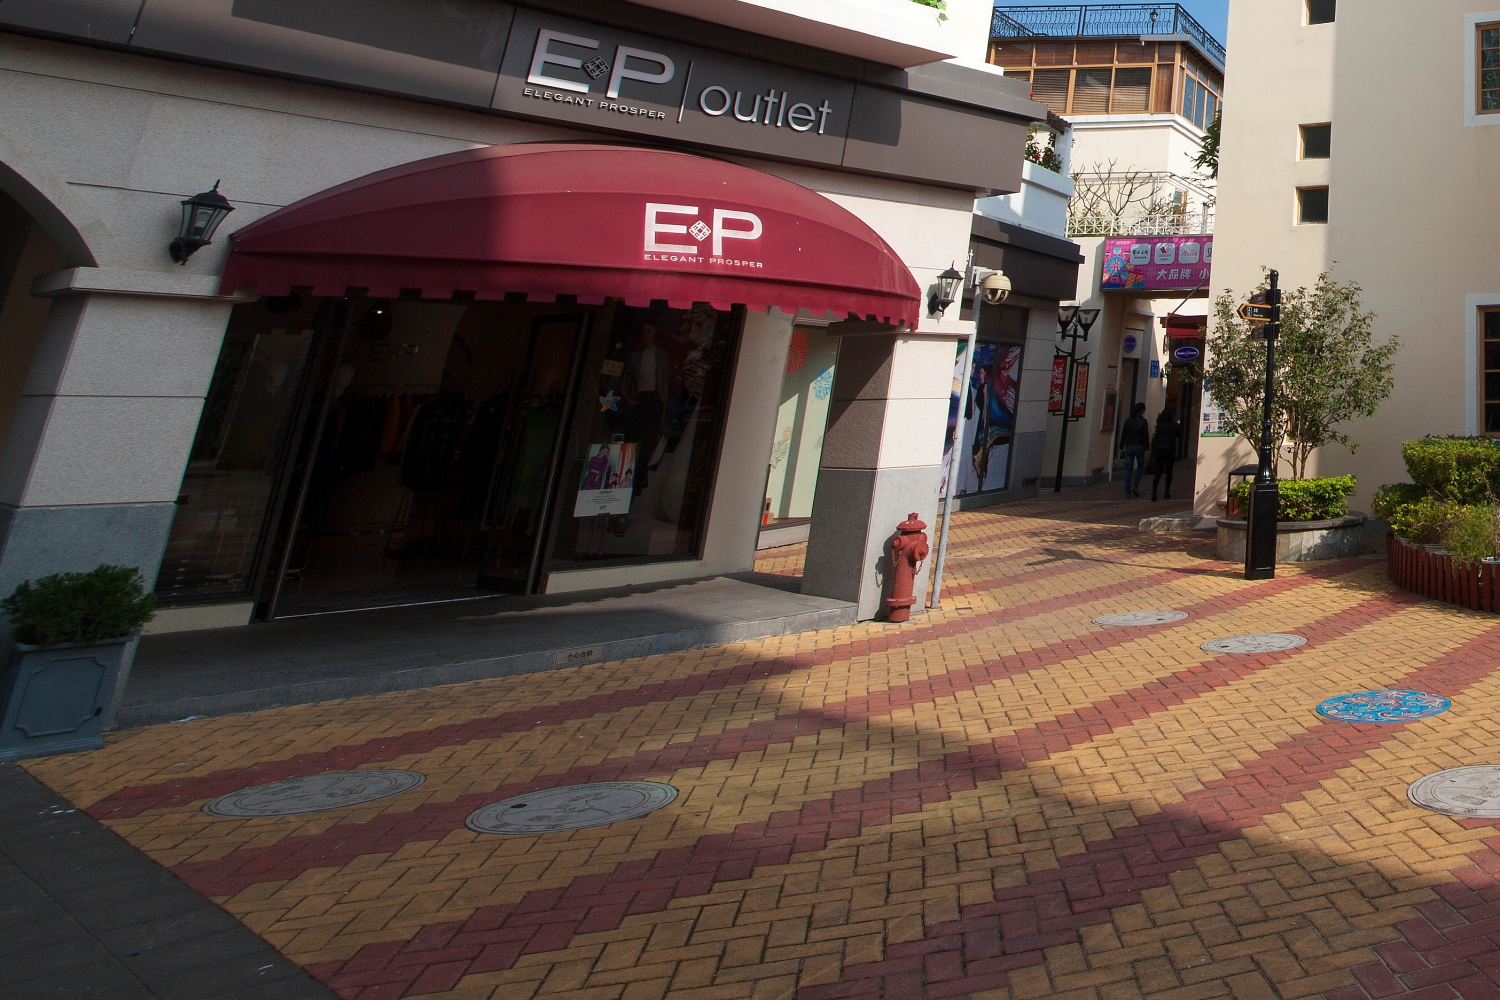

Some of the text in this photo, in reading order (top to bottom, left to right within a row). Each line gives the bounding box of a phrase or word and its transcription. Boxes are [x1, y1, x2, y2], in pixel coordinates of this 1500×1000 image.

[523, 88, 667, 120] ELEGANT PROSPER
[699, 85, 833, 135] outlet
[644, 254, 764, 269] ELEGANT PROSPER
[1156, 268, 1192, 281] 大品牌
